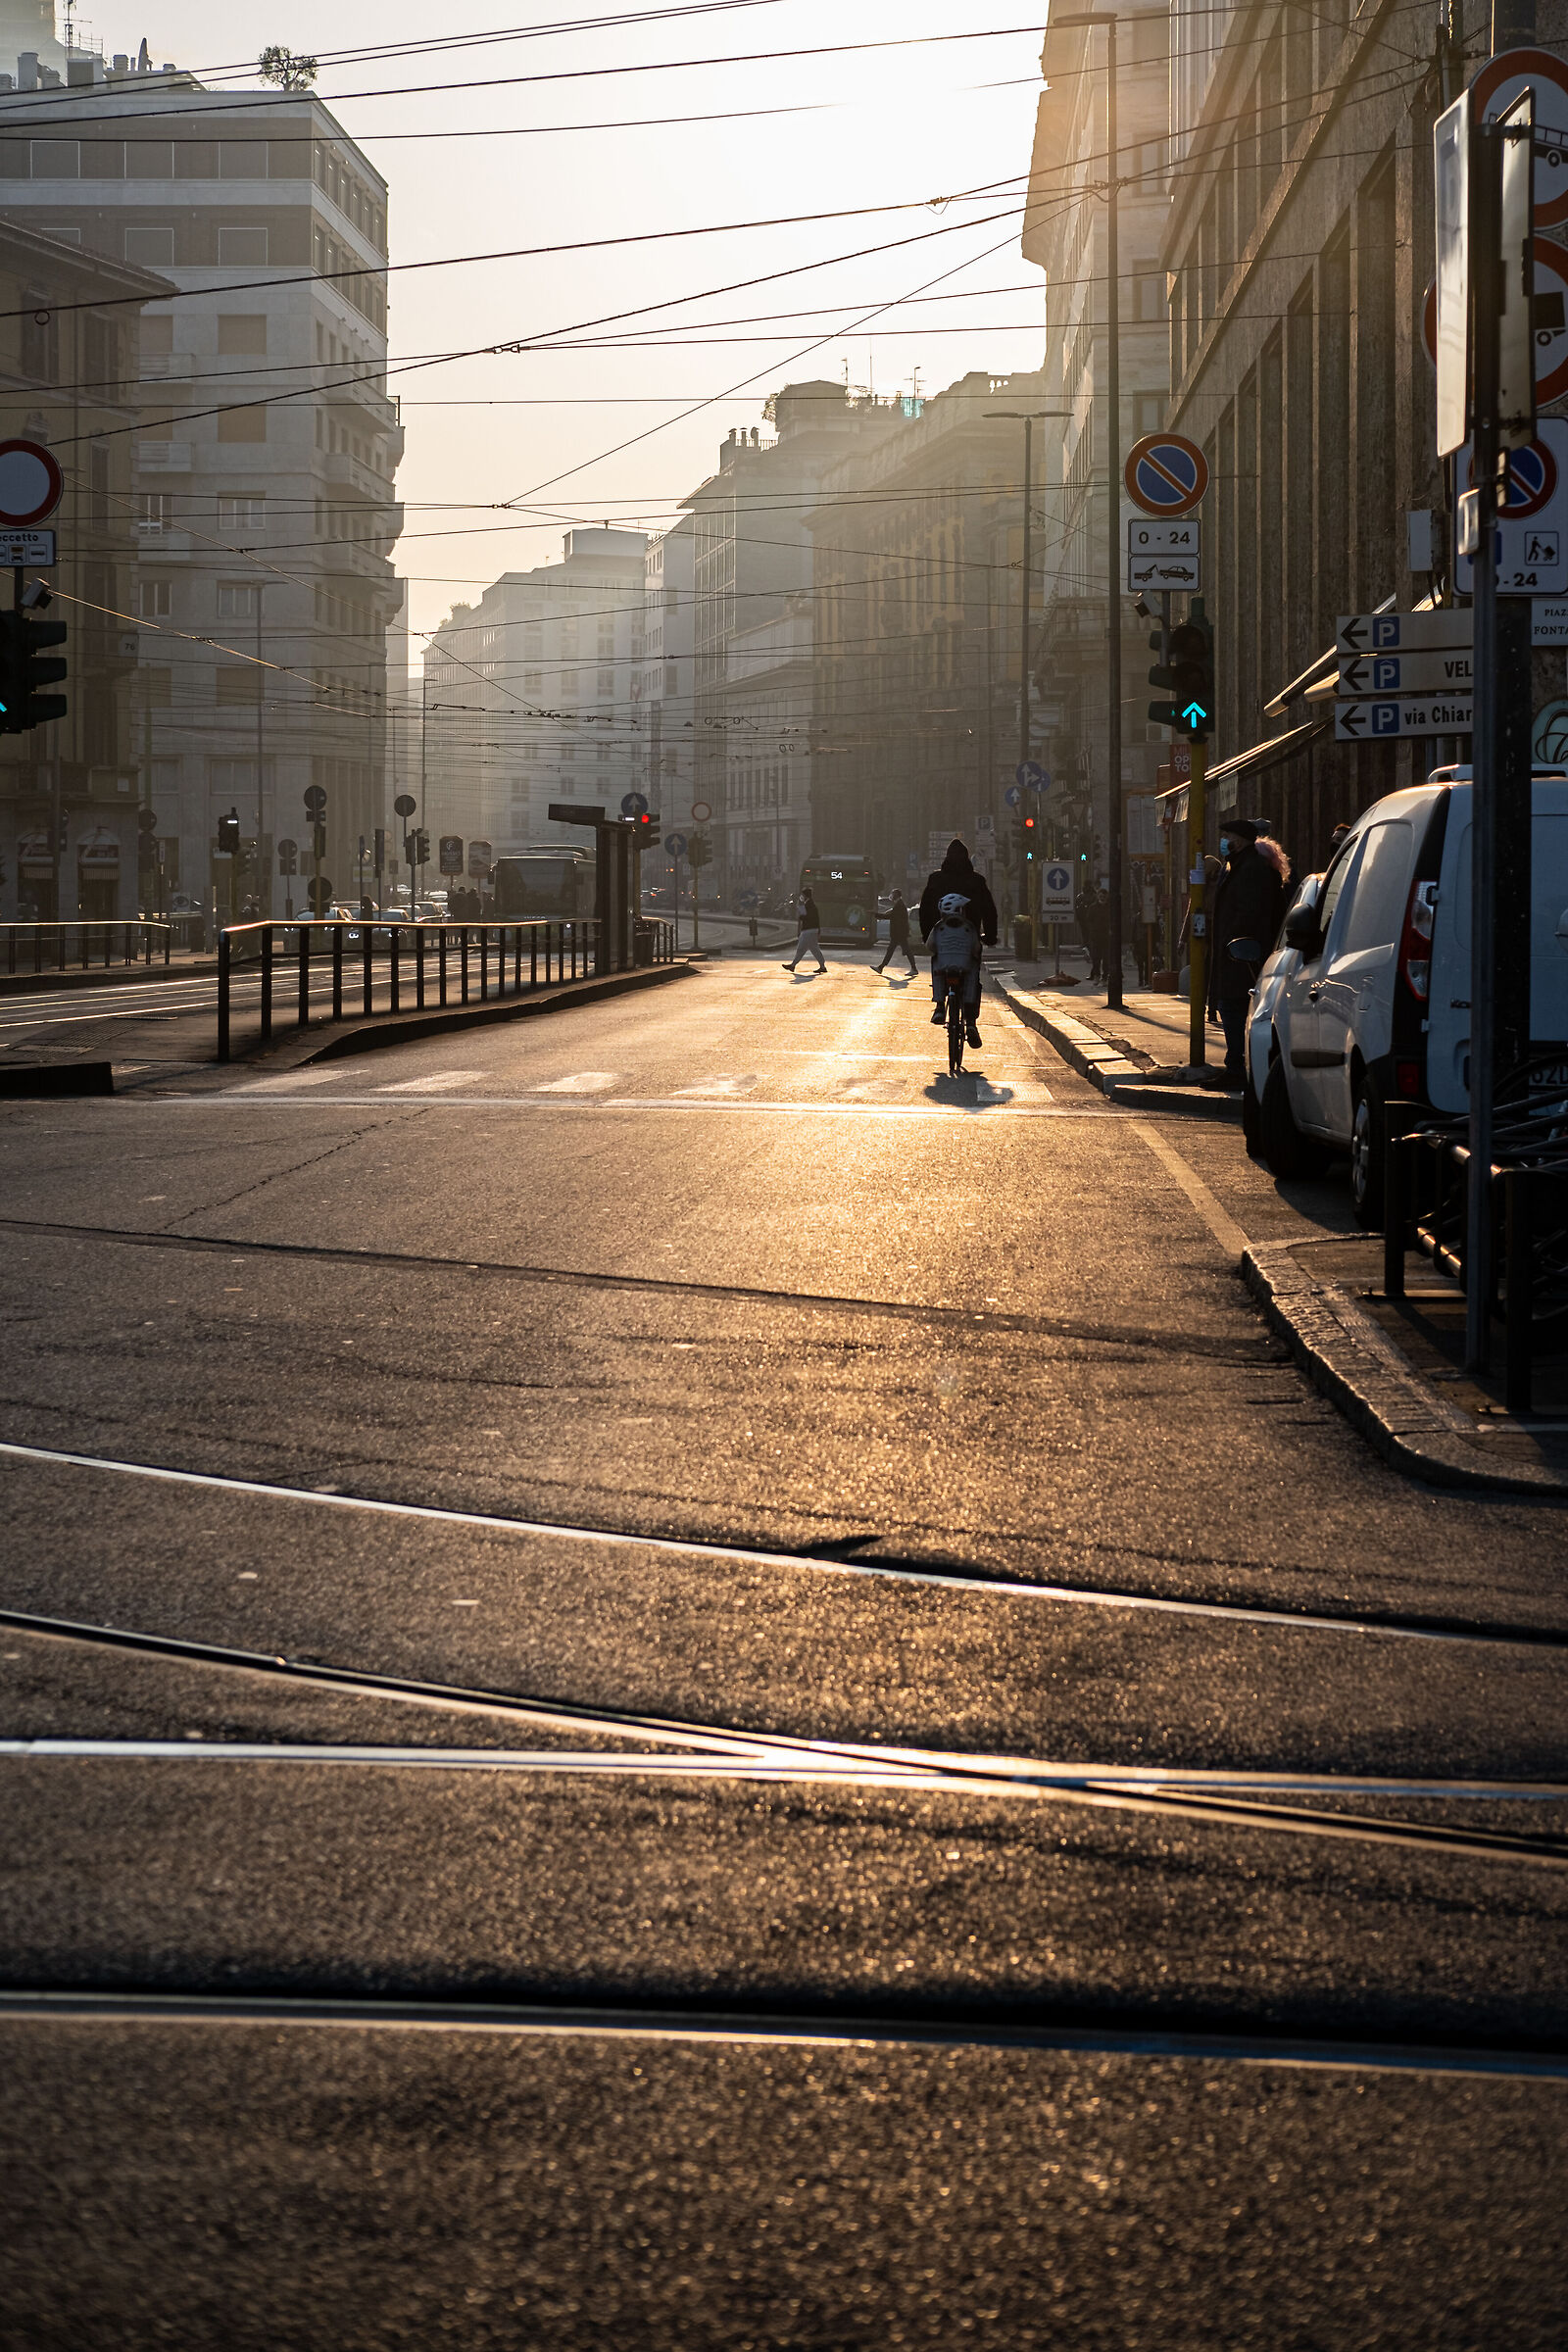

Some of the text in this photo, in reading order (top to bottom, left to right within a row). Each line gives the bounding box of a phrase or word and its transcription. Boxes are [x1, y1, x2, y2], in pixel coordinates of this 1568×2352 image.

[0, 533, 39, 542] ccetto
[1139, 531, 1149, 544] 0
[1169, 531, 1191, 544] 24
[1513, 572, 1538, 586] 24
[1445, 661, 1473, 678] VEL
[1404, 708, 1426, 725] via
[1432, 705, 1472, 723] Chiar
